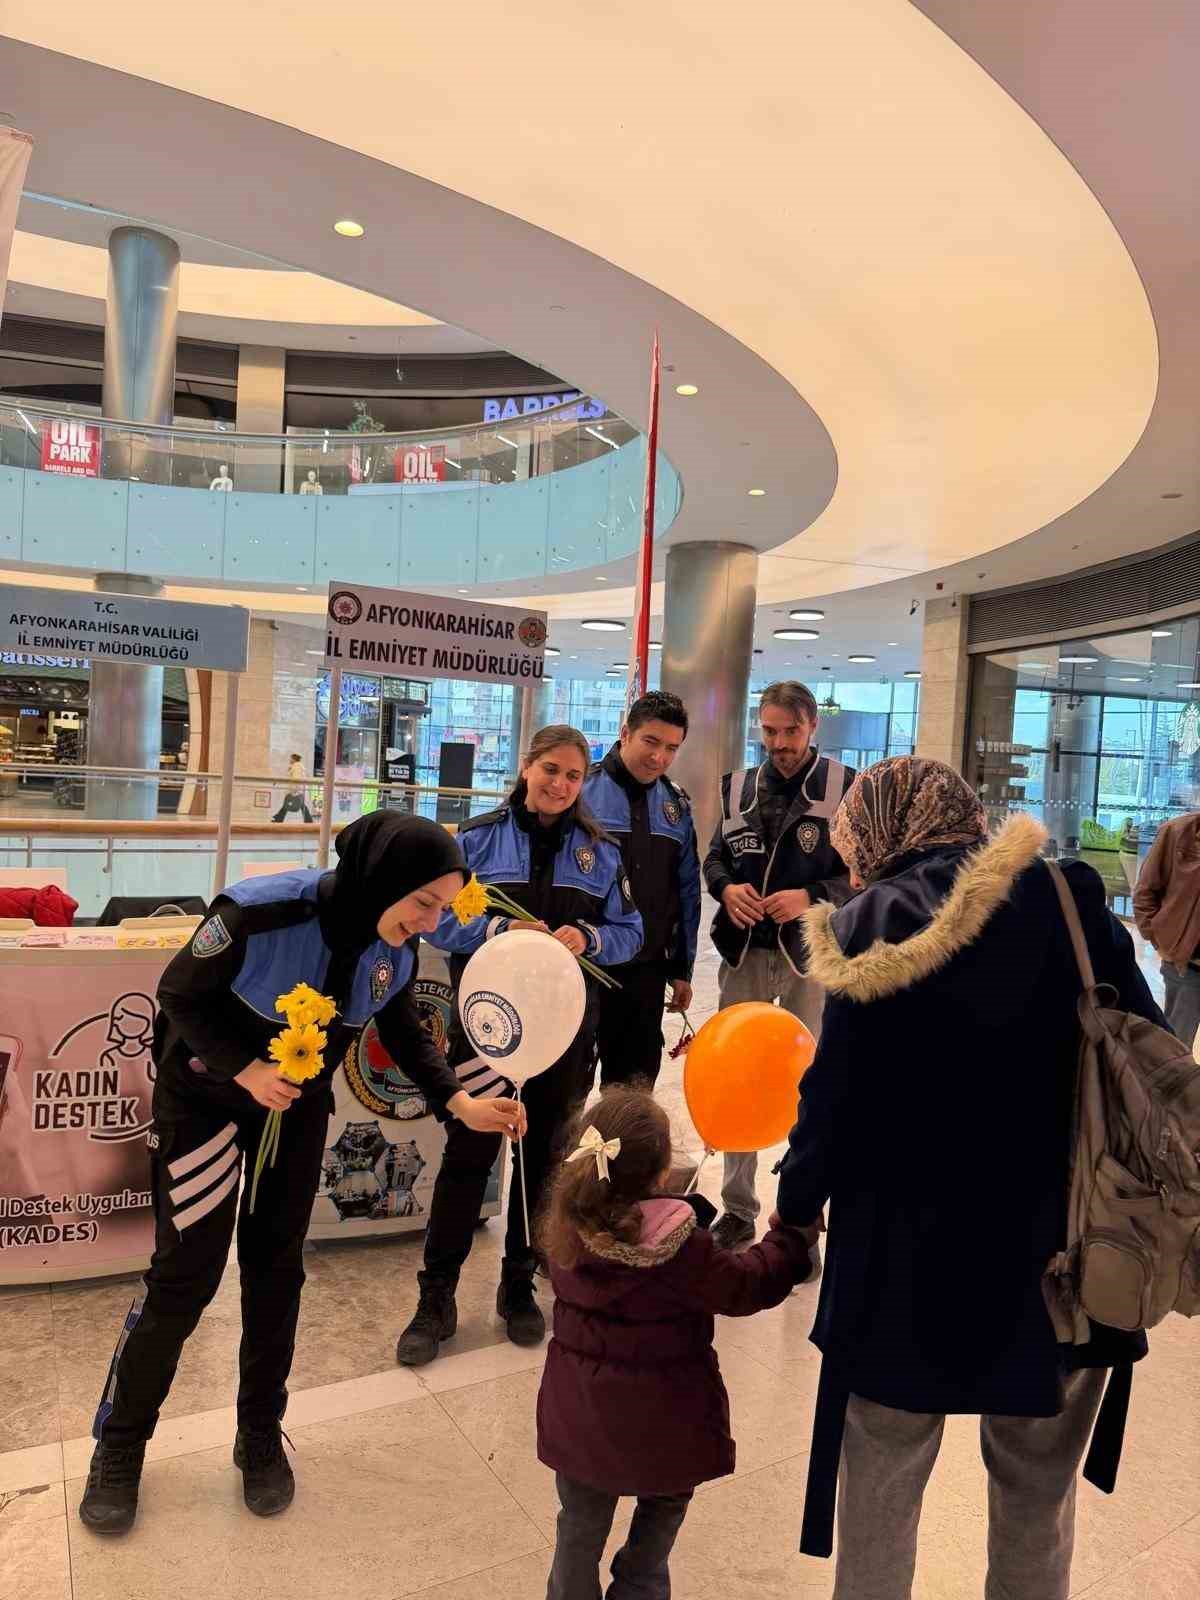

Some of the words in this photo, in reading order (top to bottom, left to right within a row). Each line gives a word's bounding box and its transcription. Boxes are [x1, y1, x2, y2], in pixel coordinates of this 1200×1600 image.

[50, 443, 91, 464] PARK
[404, 450, 438, 478] OIL
[94, 601, 118, 614] T.C.
[366, 603, 514, 640] AFYONKARAHİSAR
[9, 613, 139, 636] AFYONKARAHİSAR
[142, 625, 199, 642] VALİLİĞİ
[17, 631, 30, 646] İL
[33, 635, 95, 652] EMNİYET
[98, 640, 189, 660] MÜDÜRLÜĞÜ
[327, 630, 342, 657] İL
[349, 638, 427, 667] EMNİYET
[432, 645, 543, 678] MÜDÜRLÜĞÜ
[35, 1069, 118, 1099] KADIN
[33, 1098, 137, 1130] DESTEK
[10, 1194, 76, 1216] Destek
[0, 1221, 99, 1249] (KADES)
